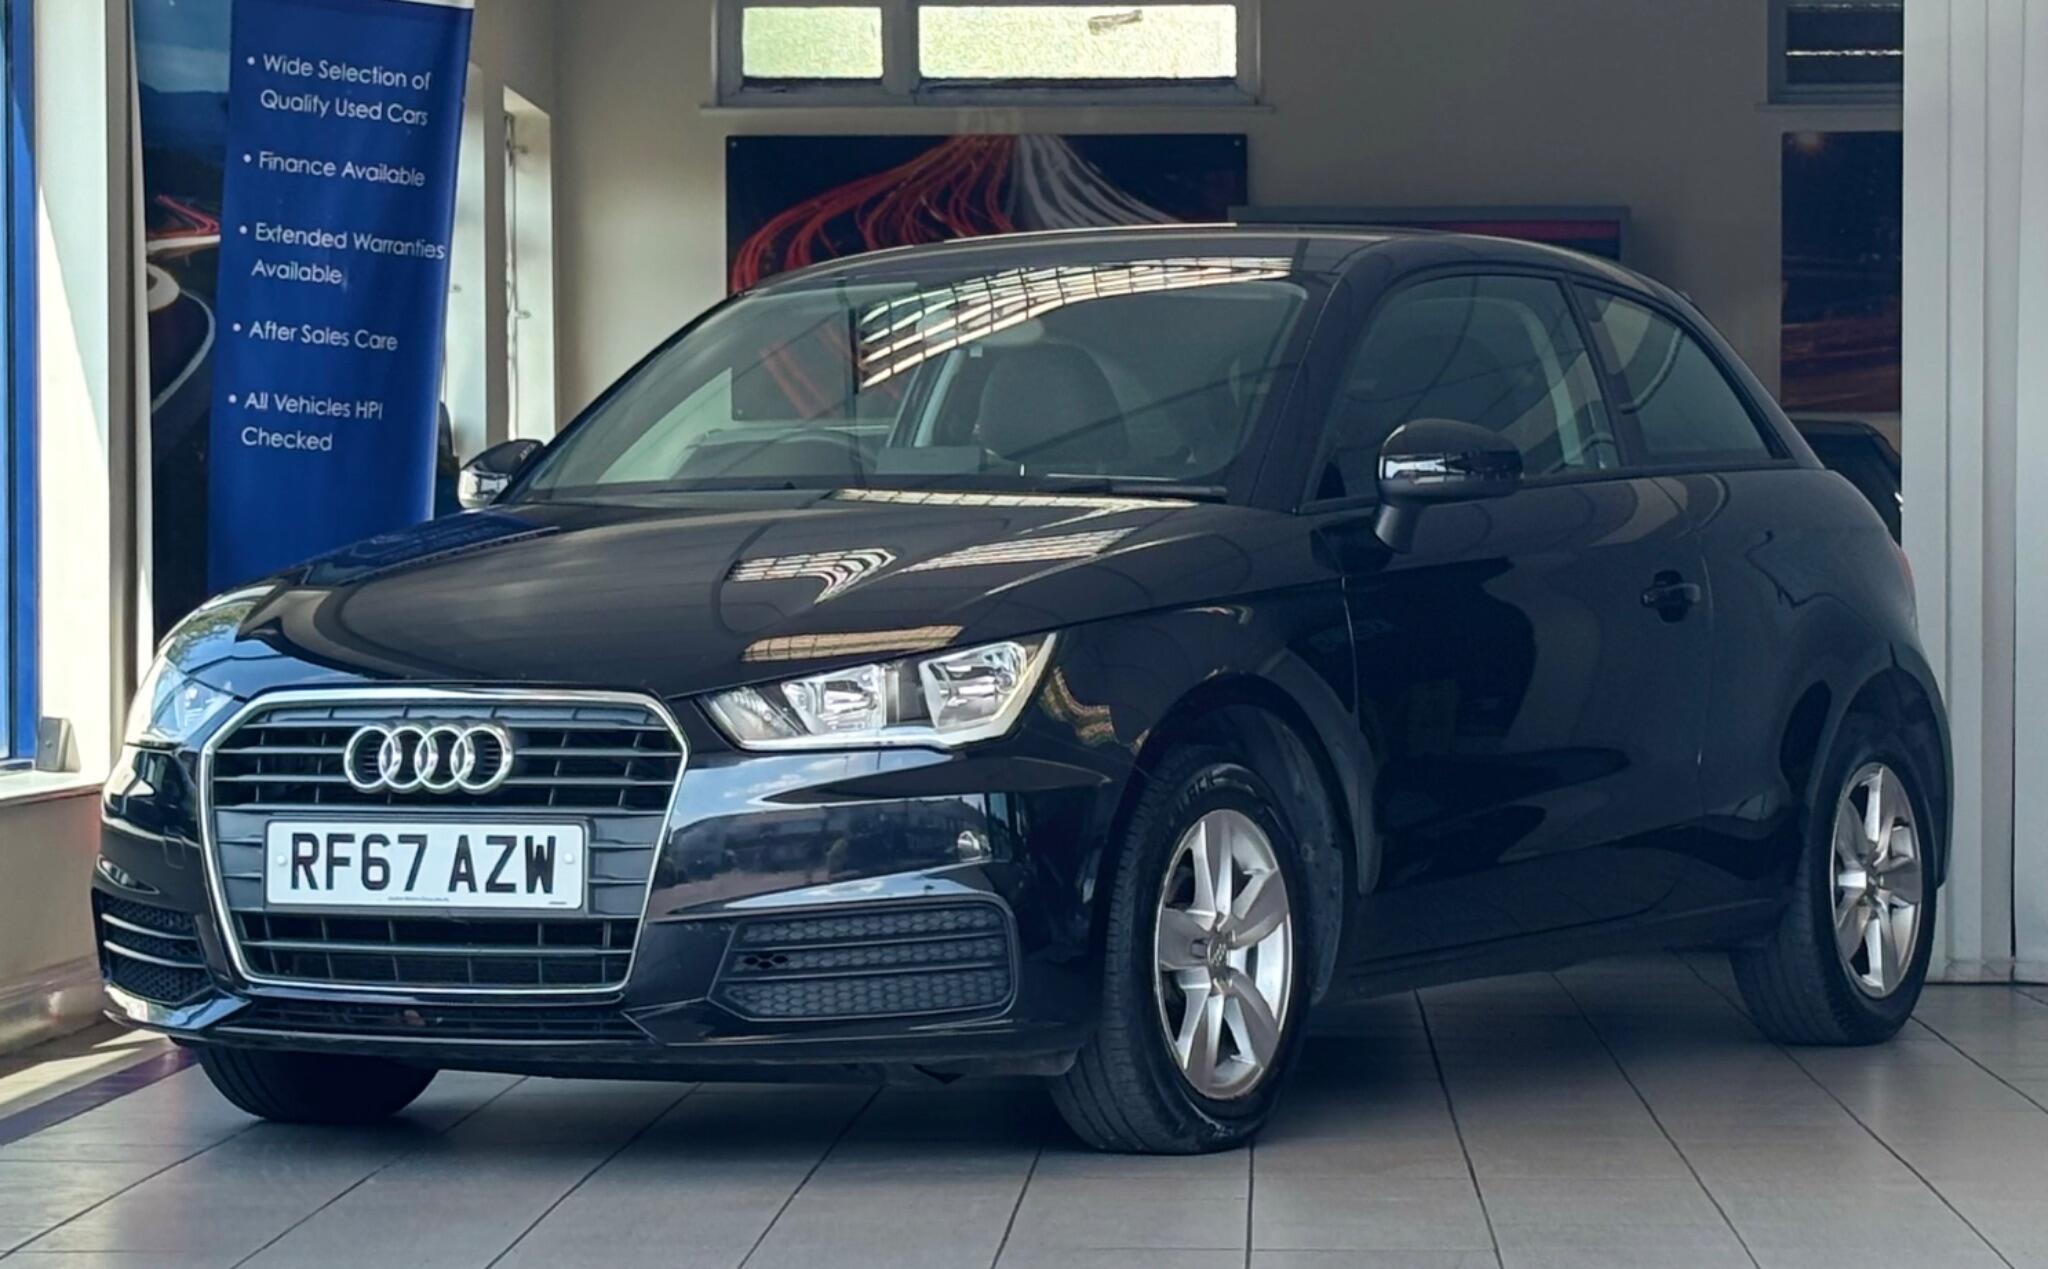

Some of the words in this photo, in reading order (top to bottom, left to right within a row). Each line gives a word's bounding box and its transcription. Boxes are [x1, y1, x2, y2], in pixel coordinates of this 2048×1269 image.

[263, 53, 313, 77] Wide
[318, 60, 406, 88] Selection
[411, 72, 431, 90] of
[260, 89, 330, 118] Quality
[335, 98, 382, 120] Used
[387, 103, 429, 126] Cars
[259, 151, 336, 176] Finance
[341, 161, 426, 187] Available
[255, 222, 347, 249] Extended
[353, 232, 446, 259] Warranties
[251, 259, 343, 284] Available
[249, 320, 297, 342] After
[301, 324, 350, 347] Sales
[354, 329, 398, 351] Care
[244, 392, 269, 410] All
[274, 394, 351, 418] Vehicles
[355, 401, 383, 420] HPI
[241, 426, 333, 451] Checked
[290, 832, 428, 892] RF67
[448, 834, 557, 895] AZW
